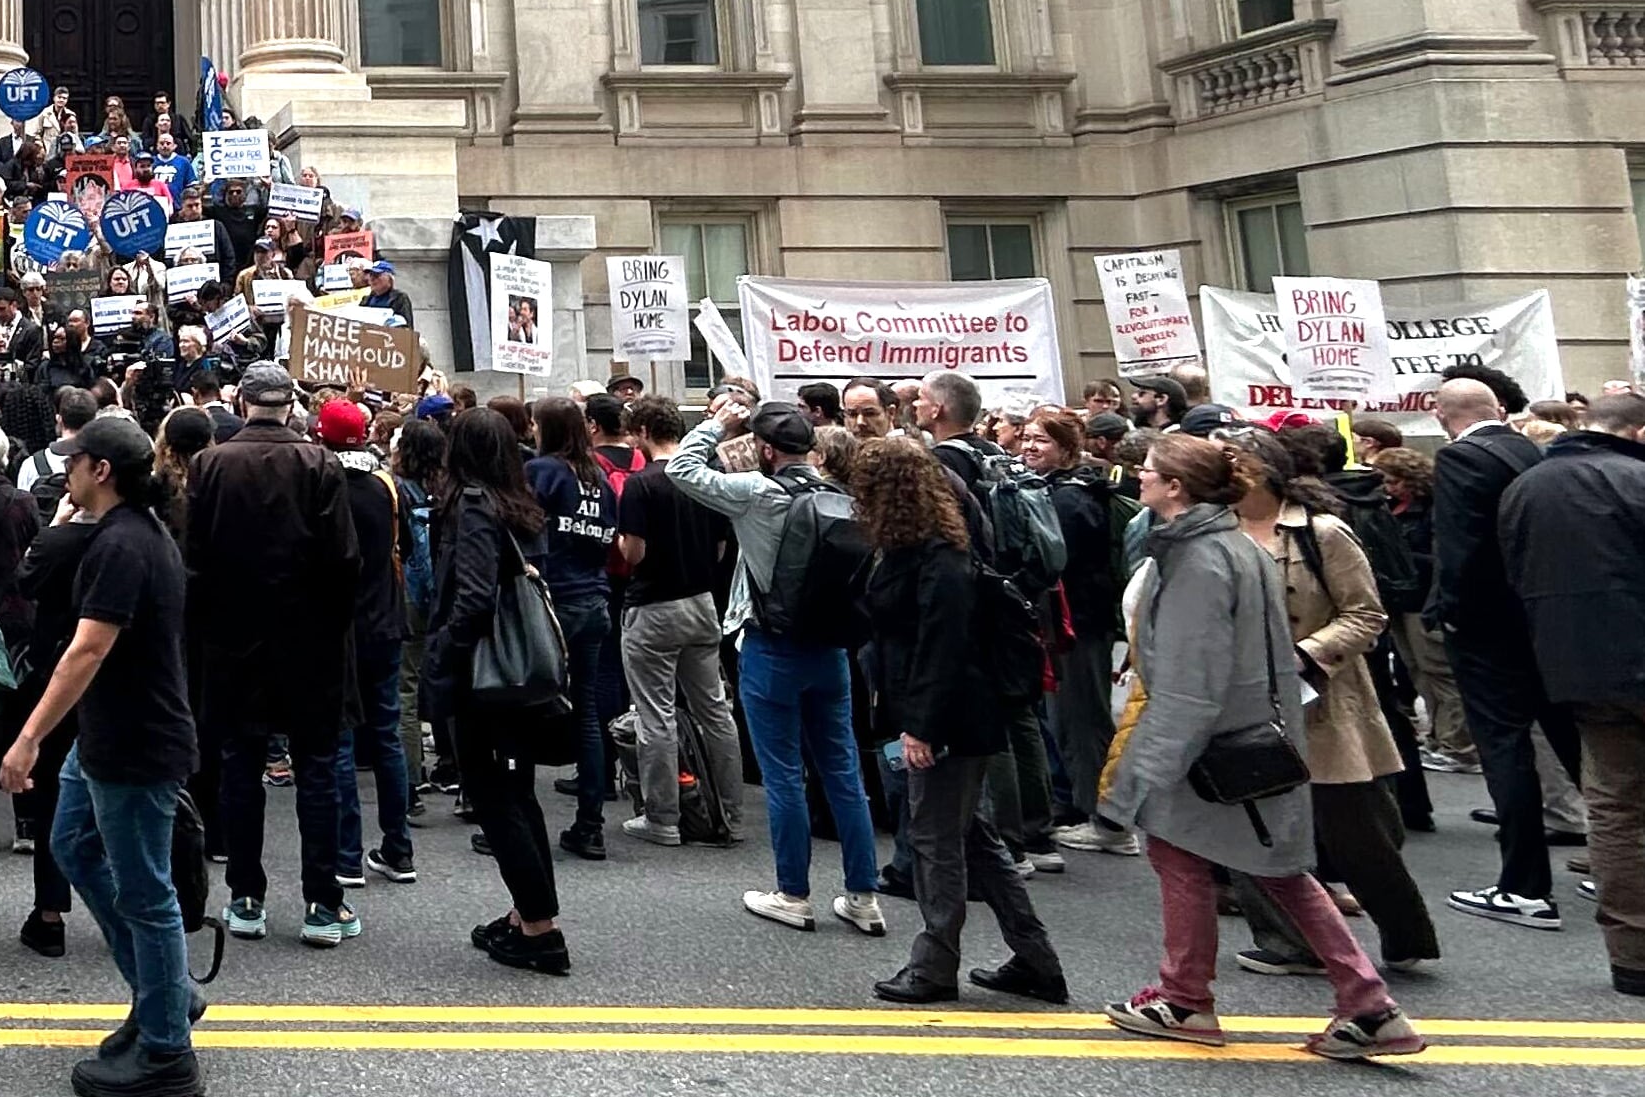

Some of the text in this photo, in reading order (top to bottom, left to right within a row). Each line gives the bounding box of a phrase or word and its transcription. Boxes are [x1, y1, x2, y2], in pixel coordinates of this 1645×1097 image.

[7, 86, 39, 102] UFT
[36, 217, 77, 247] UFT
[112, 208, 151, 238] UFT
[622, 260, 669, 282] BRING
[1103, 255, 1164, 272] CAPITALISM
[1115, 276, 1127, 287] IS
[620, 289, 667, 309] DYLAN
[1292, 289, 1356, 315] BRING
[634, 312, 664, 329] HOME
[771, 307, 1029, 334] Labor Committee to
[1129, 304, 1159, 318] FOR A
[307, 313, 361, 344] FREE
[1298, 321, 1365, 344] DYLAN
[1387, 317, 1498, 340] OLLEGE
[304, 335, 405, 369] MAHMOUD
[778, 339, 1029, 369] Defend Immigrants
[1313, 347, 1360, 366] HOME
[576, 499, 600, 518] All
[557, 516, 616, 543] Belong
